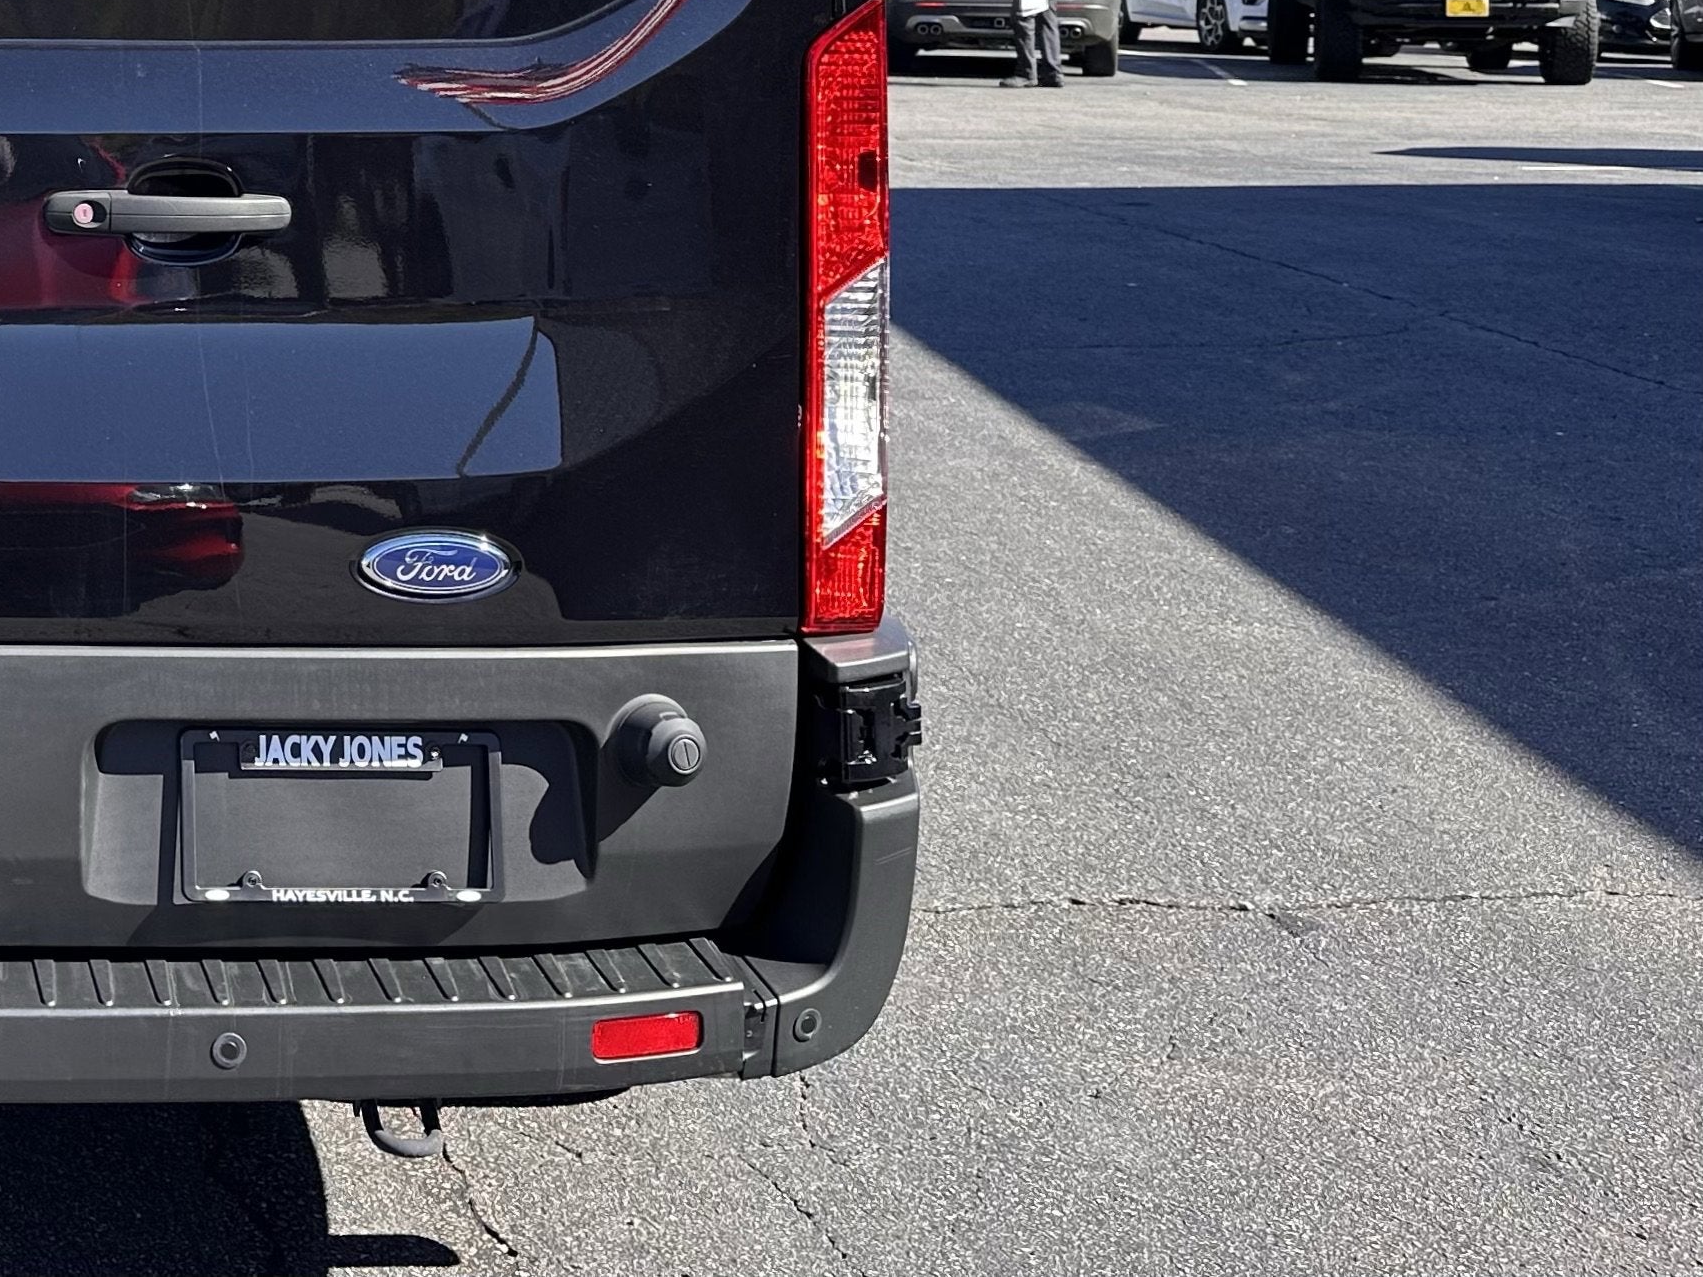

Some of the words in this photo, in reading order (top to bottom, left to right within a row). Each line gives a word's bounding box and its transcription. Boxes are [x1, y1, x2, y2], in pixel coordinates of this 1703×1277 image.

[397, 548, 477, 582] Ford
[254, 734, 337, 767] JACKY
[338, 735, 424, 768] JONES
[271, 888, 377, 903] HAYESVILLE,
[380, 889, 415, 903] N.C.
